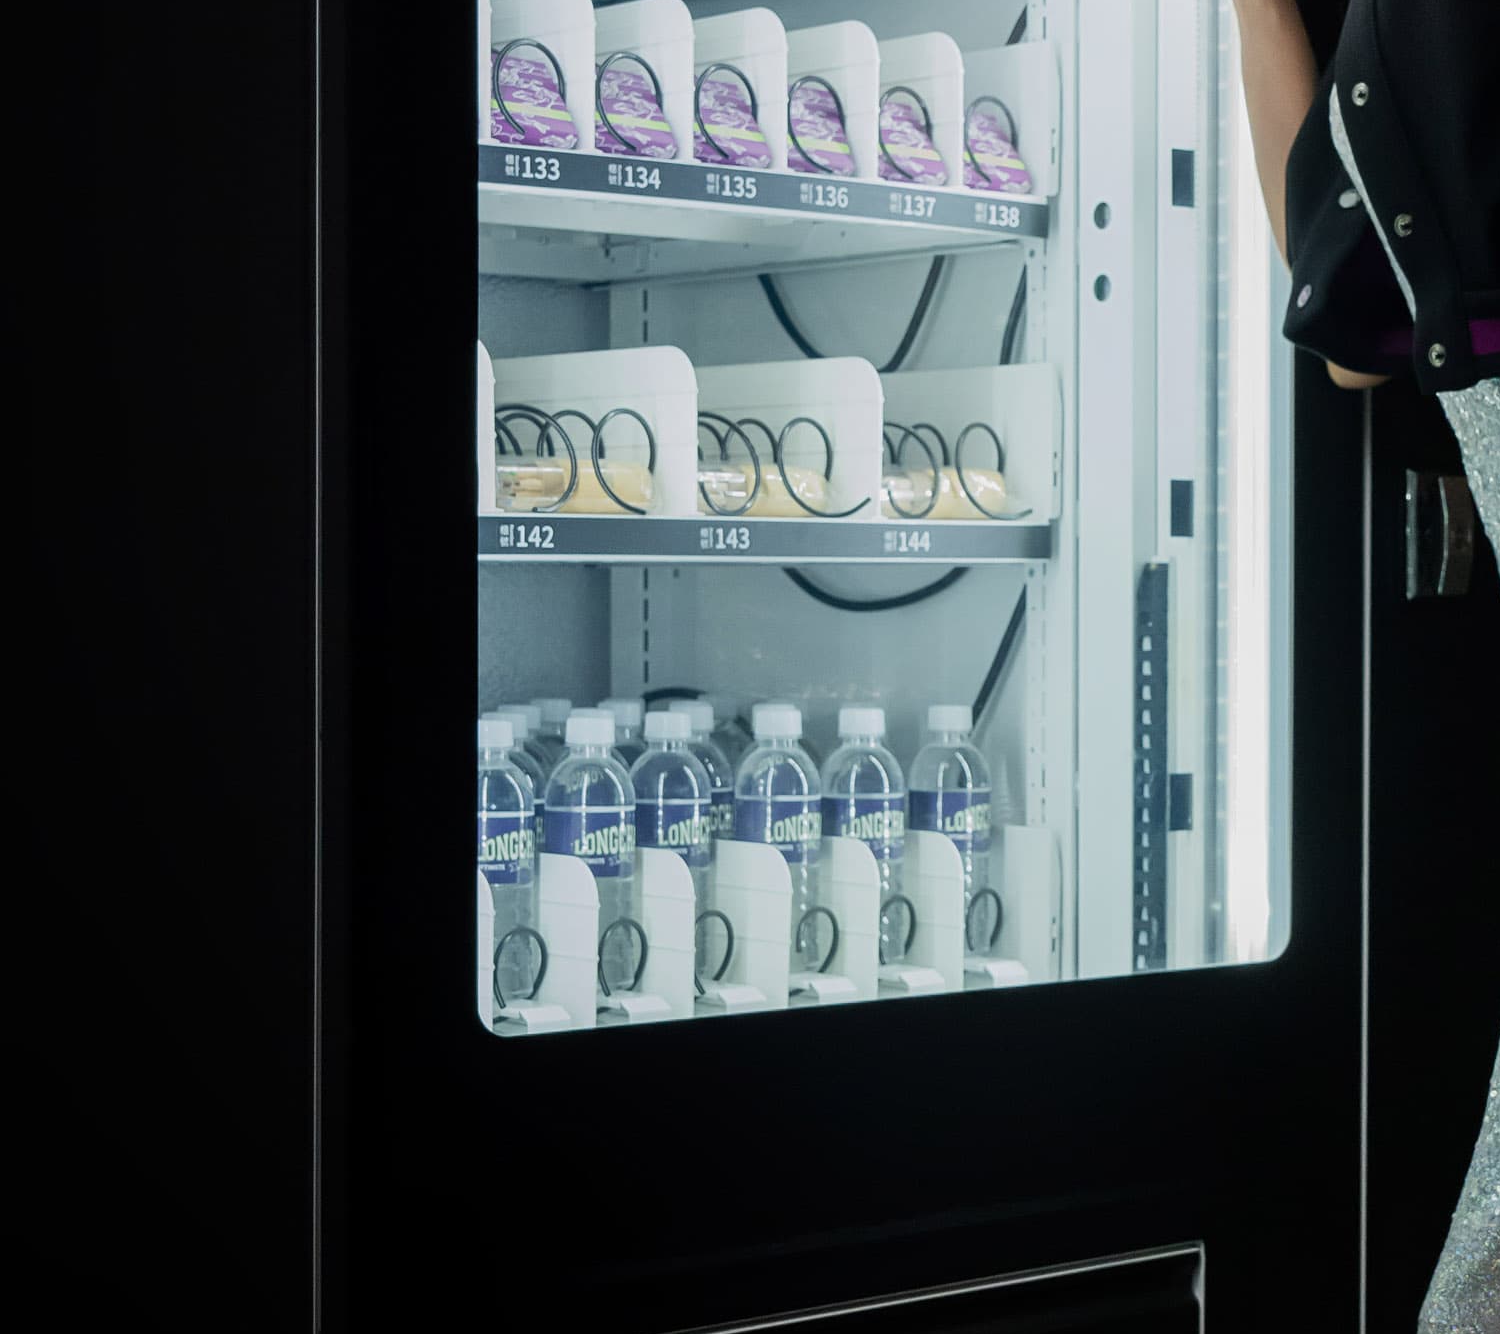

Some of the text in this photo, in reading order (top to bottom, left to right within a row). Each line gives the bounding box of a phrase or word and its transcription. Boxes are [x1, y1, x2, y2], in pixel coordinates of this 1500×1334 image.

[521, 156, 561, 181] 133
[624, 165, 662, 190] 134
[721, 175, 757, 199] 135
[815, 184, 849, 208] 136
[902, 193, 937, 217] 137
[988, 204, 1020, 228] 138
[516, 524, 555, 549] 142
[715, 527, 750, 550] 143
[898, 531, 931, 552] 144
